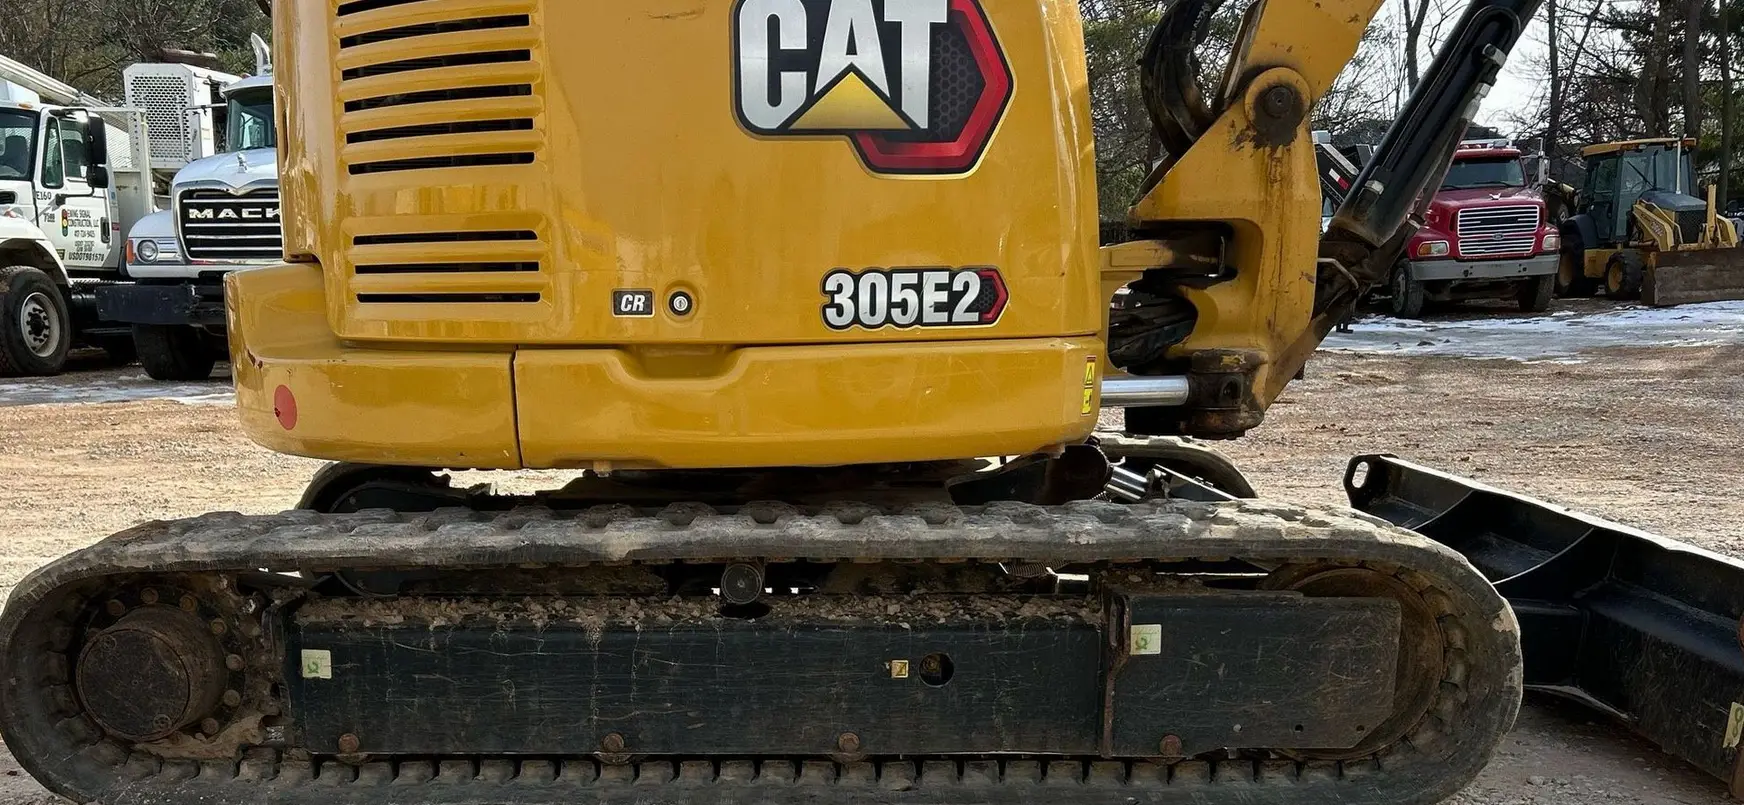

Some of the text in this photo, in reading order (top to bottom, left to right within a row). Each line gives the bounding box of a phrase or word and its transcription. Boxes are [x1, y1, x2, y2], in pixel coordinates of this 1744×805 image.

[739, 0, 948, 130] CAT
[36, 191, 52, 200] E160
[189, 208, 281, 218] MACK
[620, 294, 645, 312] CR
[825, 271, 981, 326] 305E2
